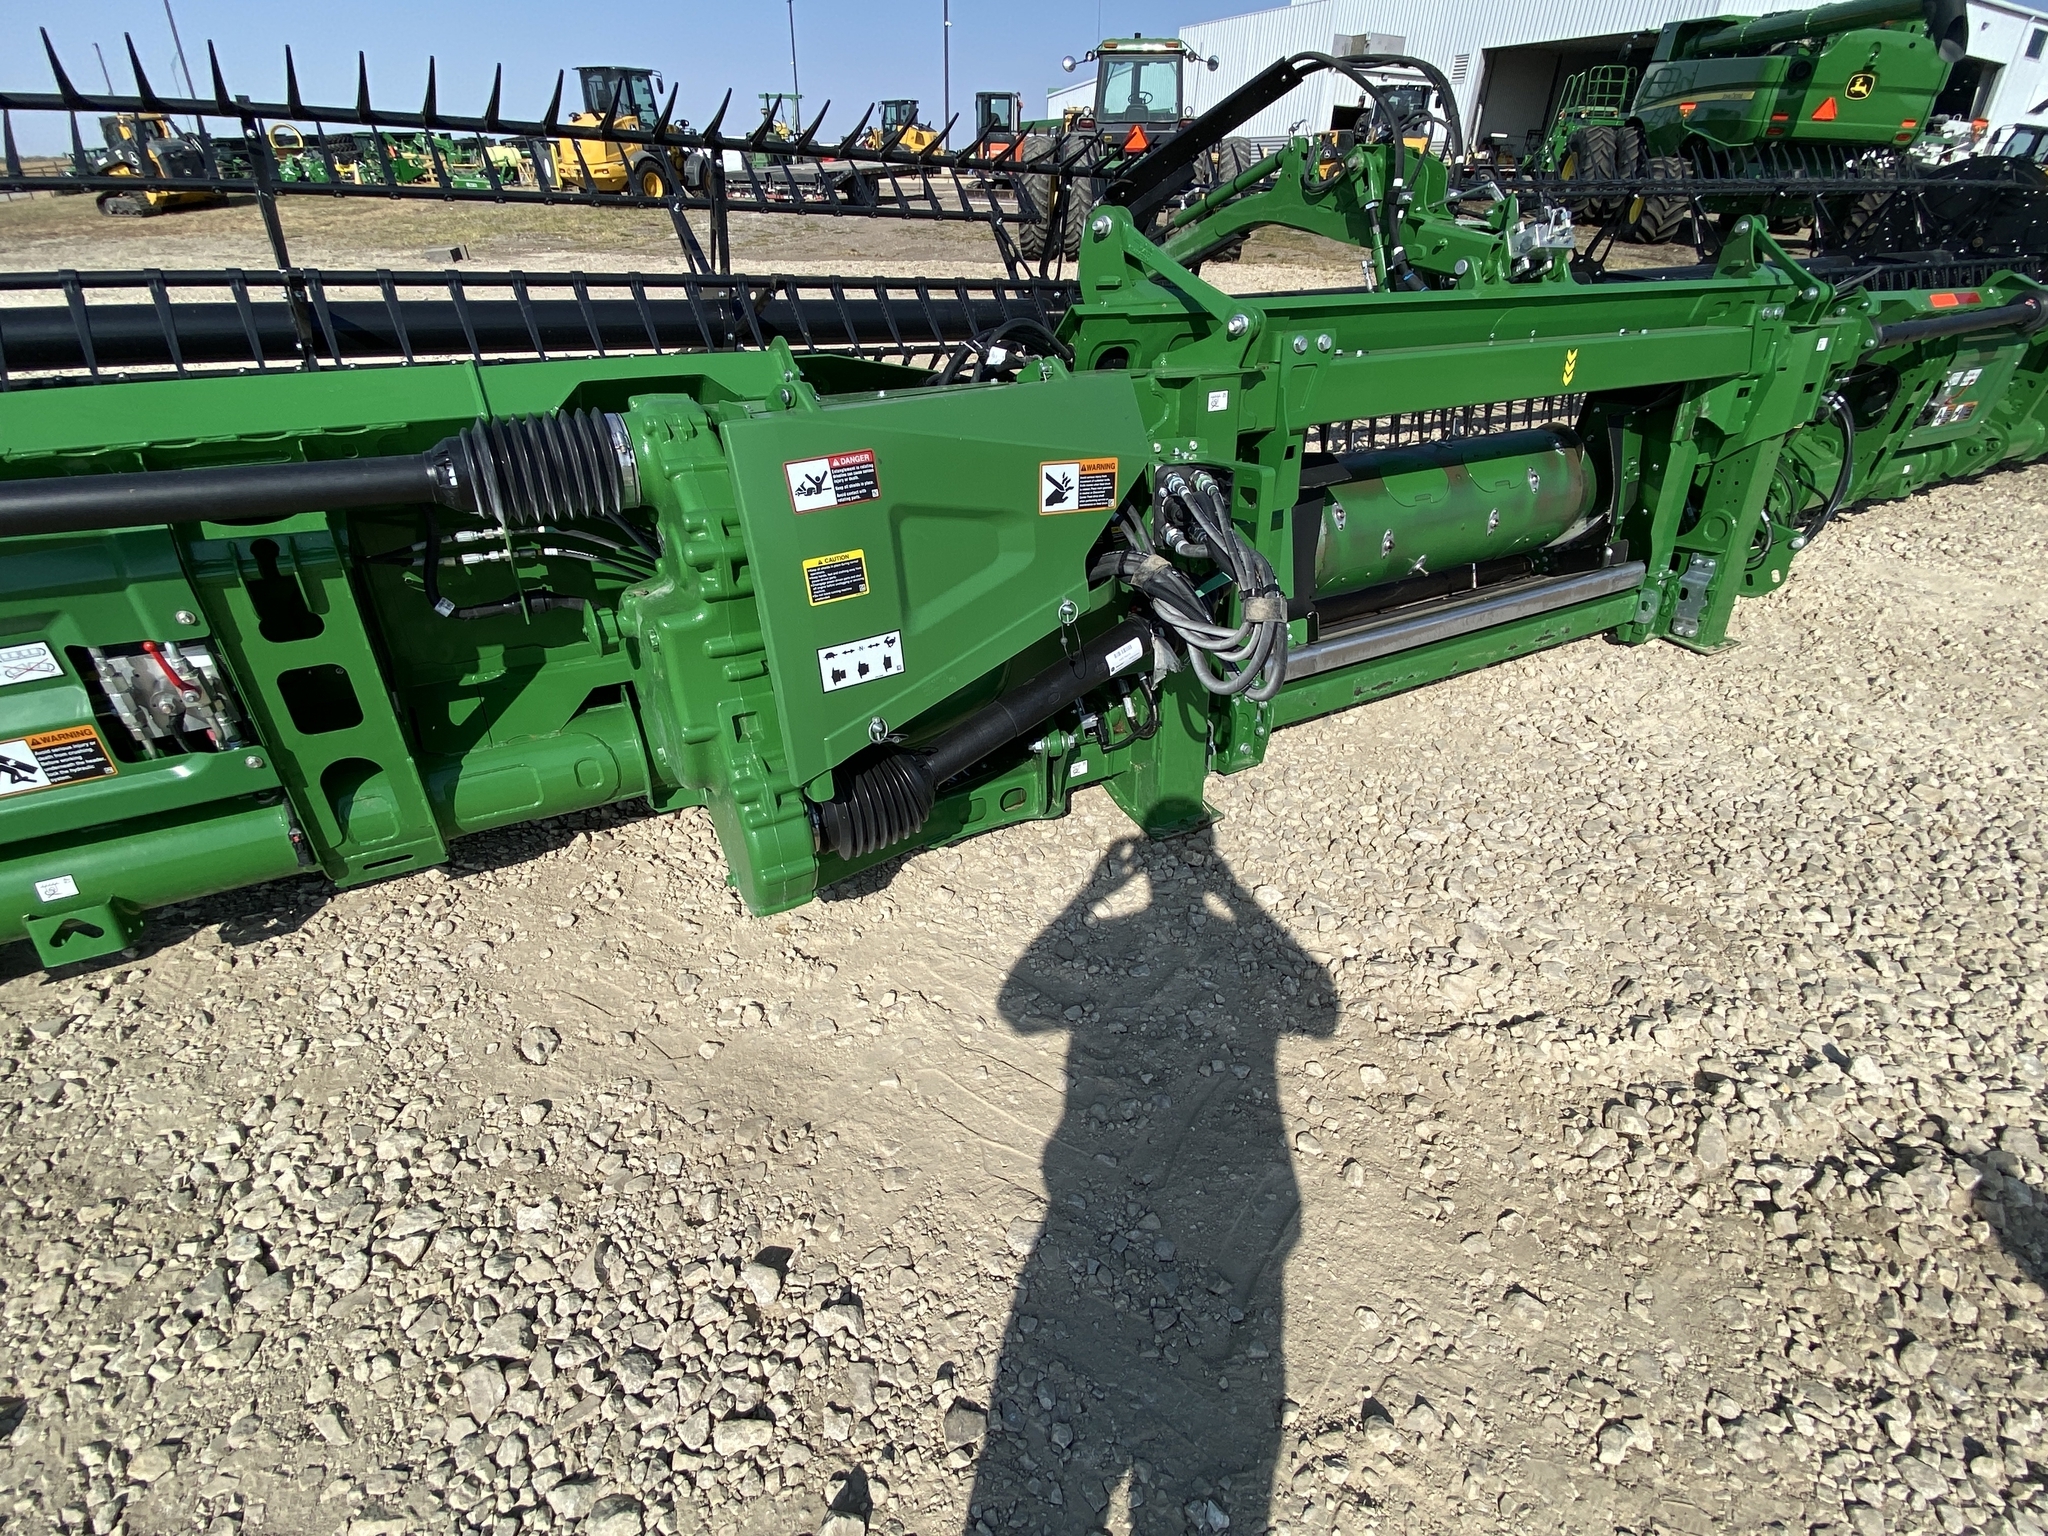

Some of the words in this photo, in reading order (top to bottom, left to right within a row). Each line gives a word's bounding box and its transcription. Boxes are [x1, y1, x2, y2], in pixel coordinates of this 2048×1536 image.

[841, 454, 869, 465] DANGER
[825, 554, 849, 563] CAUTION
[40, 729, 93, 743] WARNING
